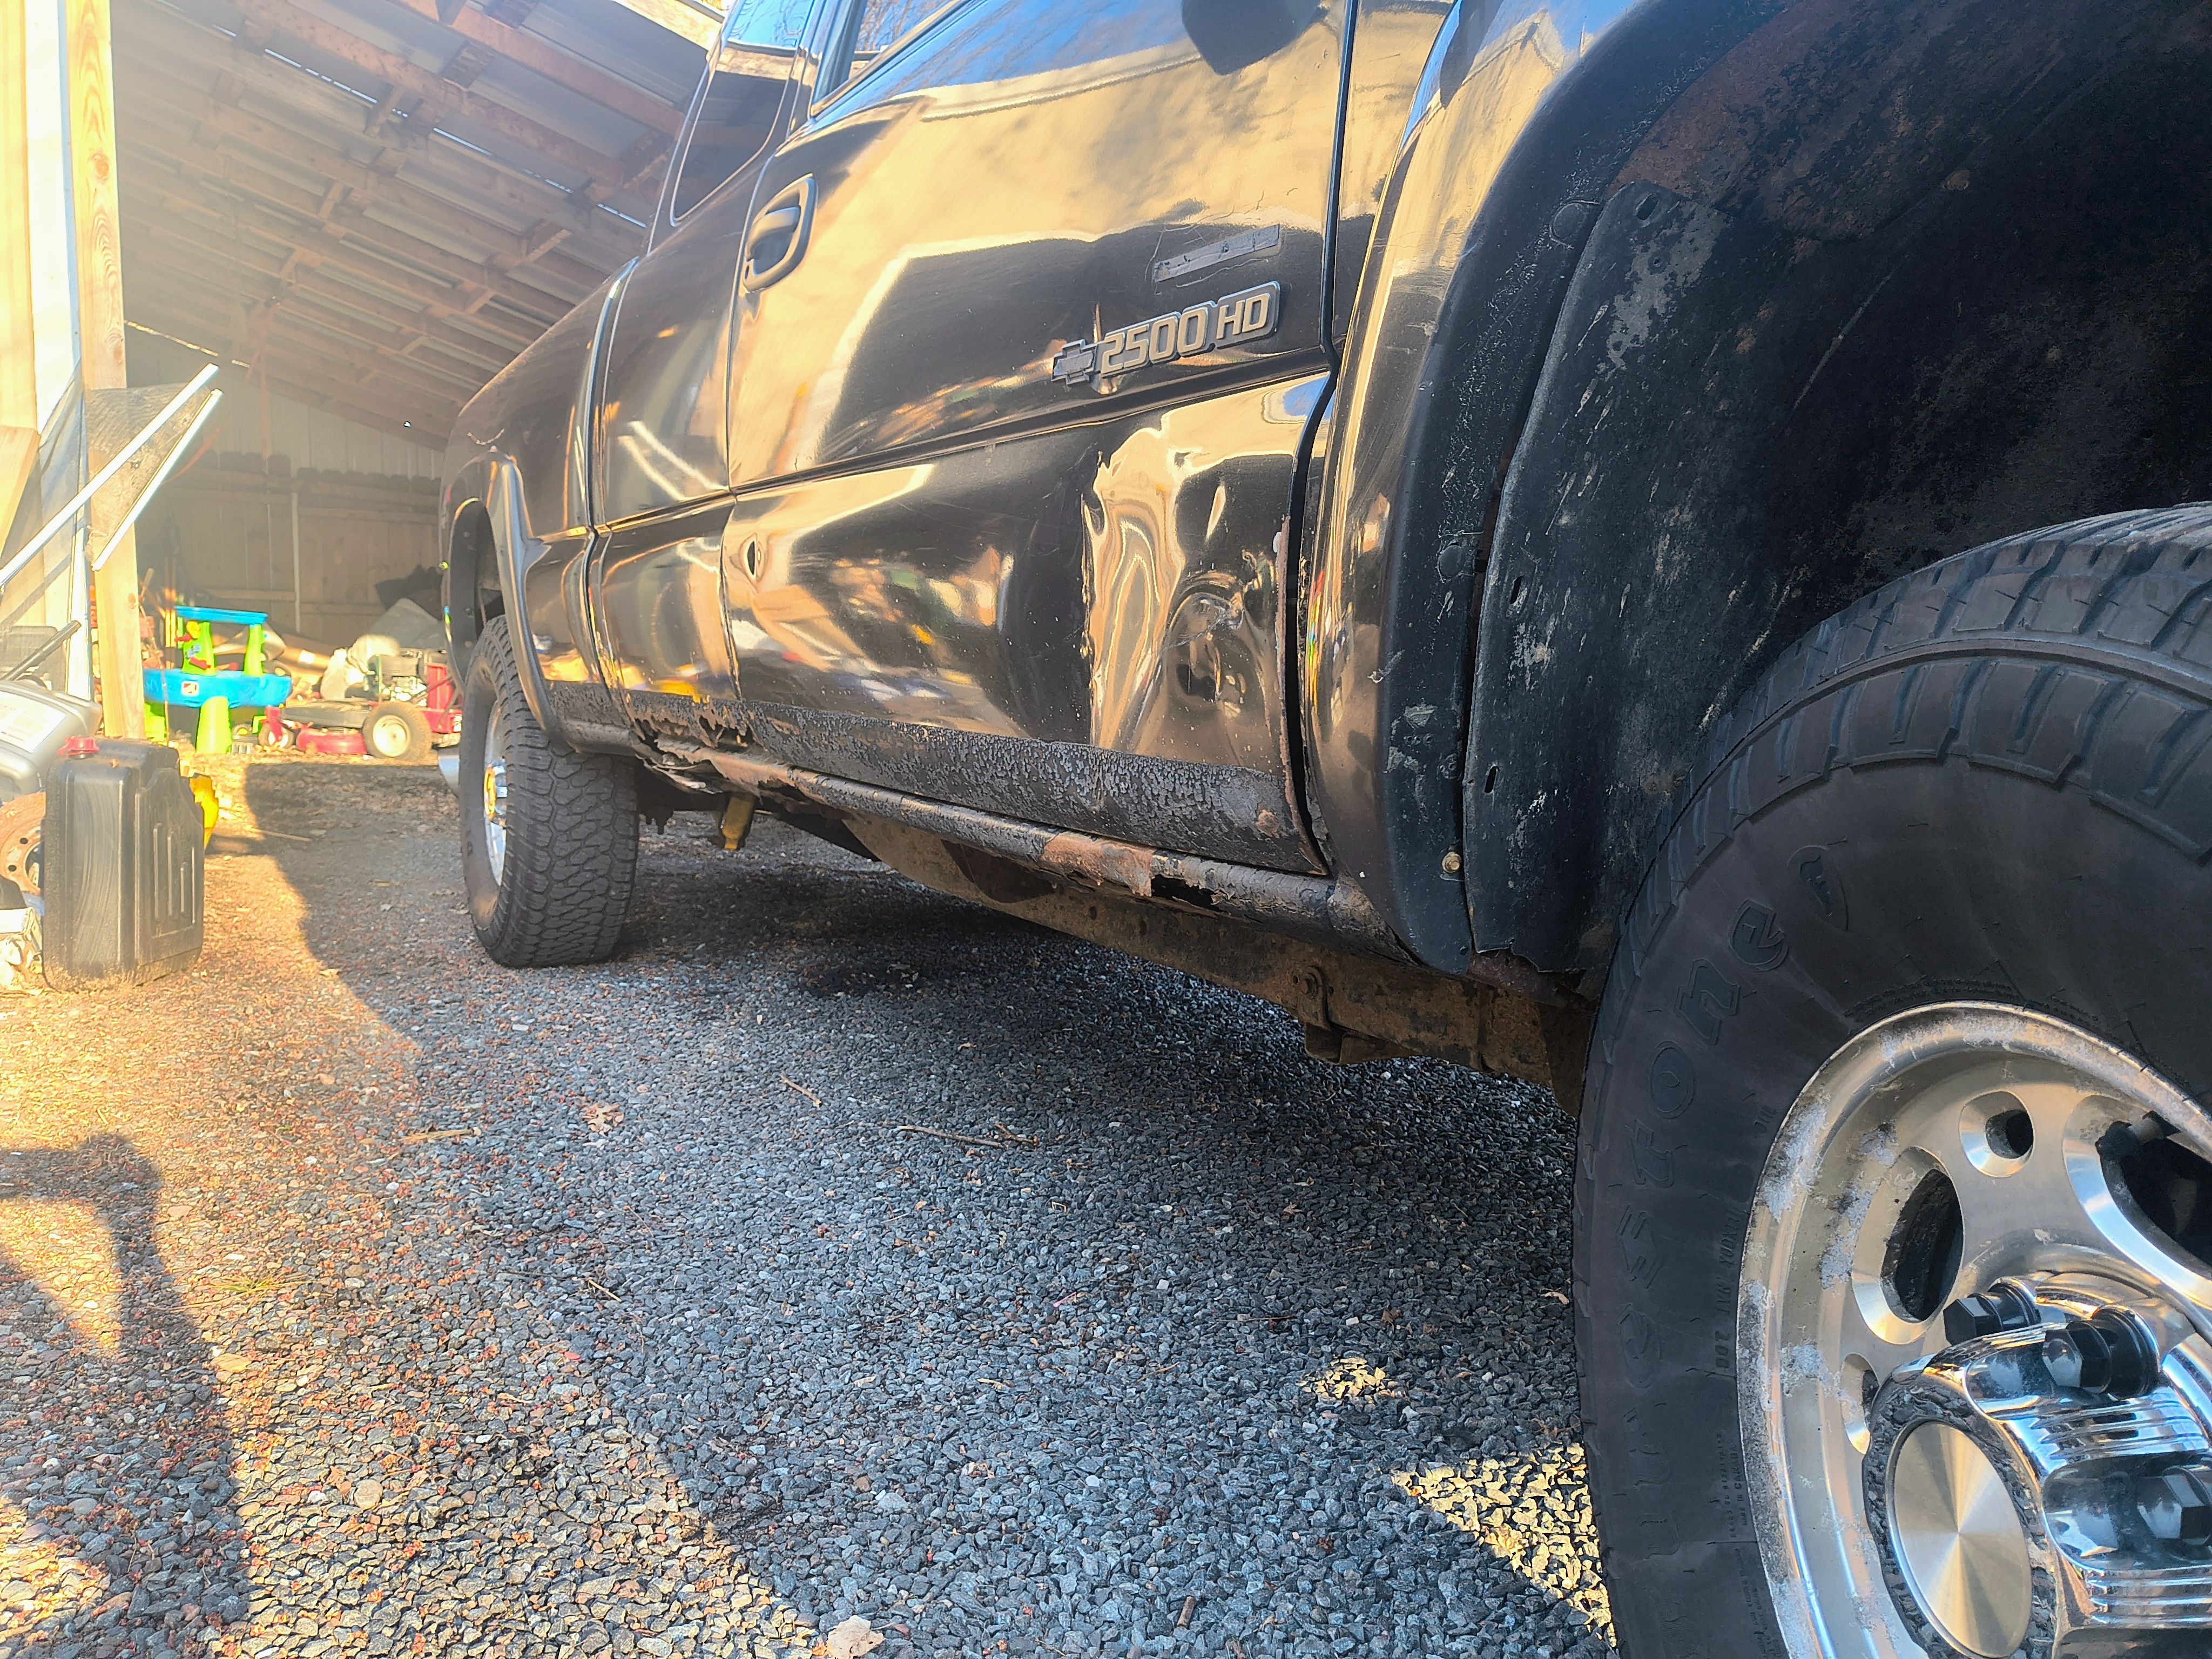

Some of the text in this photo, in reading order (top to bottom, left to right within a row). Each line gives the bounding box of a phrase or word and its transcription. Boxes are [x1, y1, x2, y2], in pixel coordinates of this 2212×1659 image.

[1101, 292, 1272, 375] 2500 HD
[1621, 899, 1789, 1650] irestone
